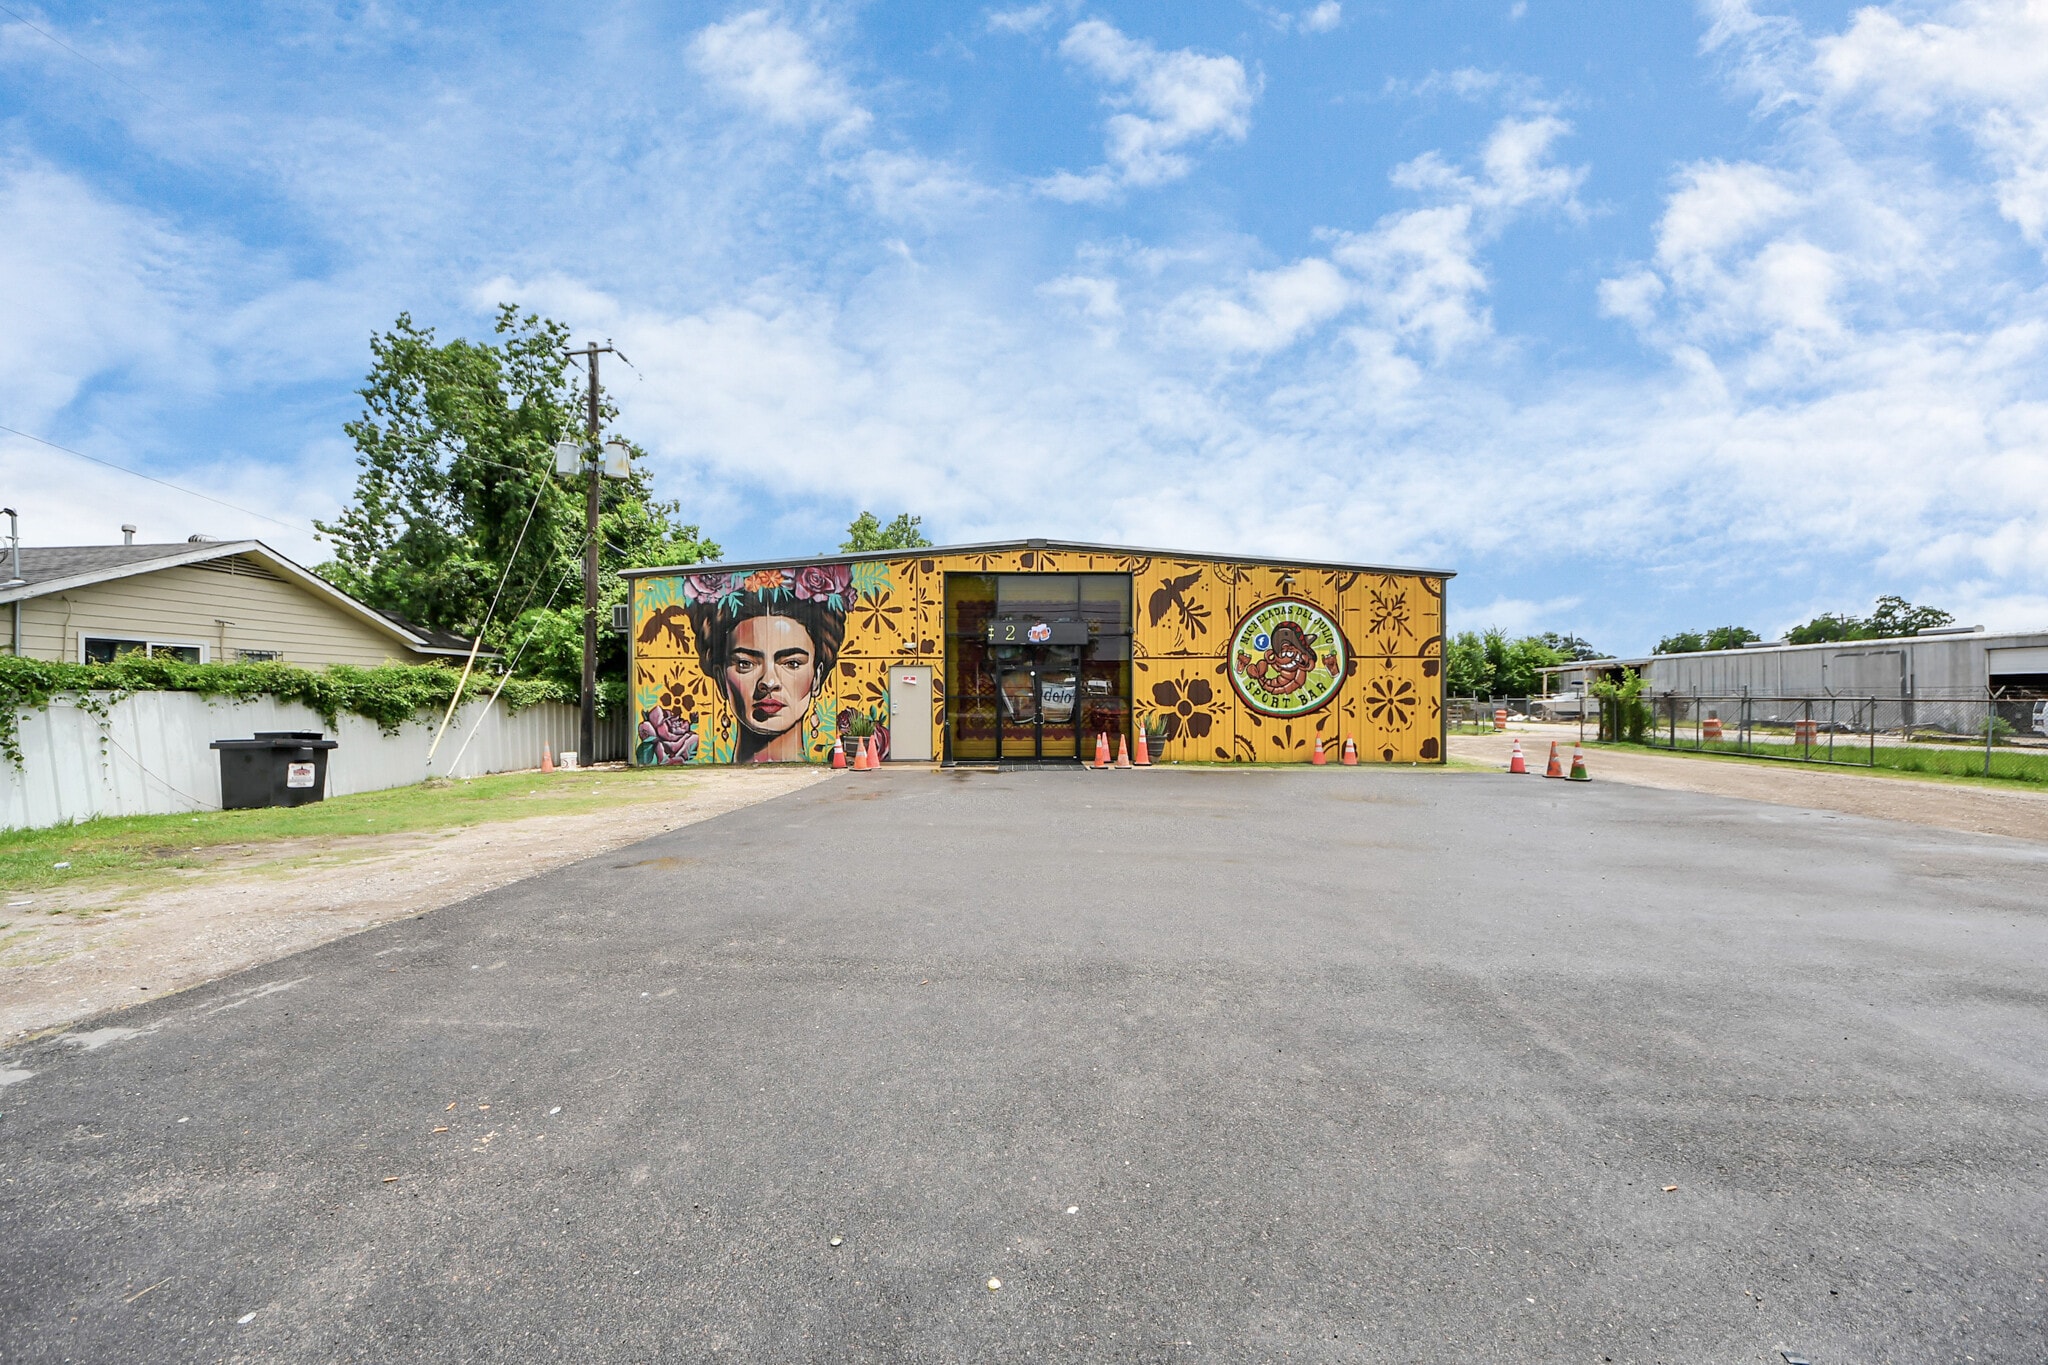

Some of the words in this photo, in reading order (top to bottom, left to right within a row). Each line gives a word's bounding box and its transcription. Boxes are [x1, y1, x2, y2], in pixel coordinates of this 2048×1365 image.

[1005, 625, 1016, 641] 2
[1240, 605, 1293, 645] MICHELADAS
[1296, 606, 1313, 621] DEL
[1313, 617, 1334, 644] JULIO
[1245, 681, 1290, 708] SPORT
[1298, 682, 1327, 706] BAR
